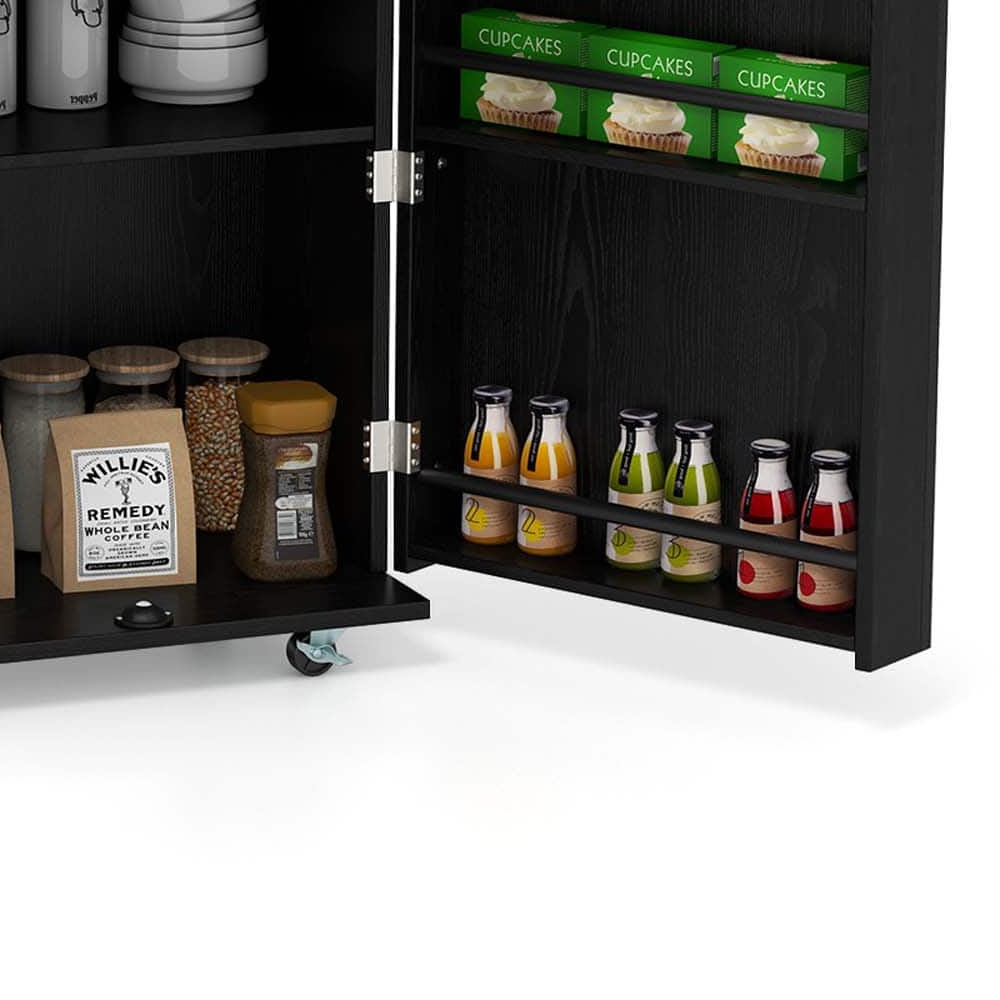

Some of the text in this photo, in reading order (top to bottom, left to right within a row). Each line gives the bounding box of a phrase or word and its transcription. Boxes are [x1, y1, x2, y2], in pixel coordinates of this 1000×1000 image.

[478, 28, 563, 57] CUPCAKES
[606, 48, 694, 78] CUPCAKES
[737, 69, 826, 99] CUPCAKES
[82, 457, 166, 485] WILLIE'S
[88, 504, 165, 521] REMEDY
[85, 526, 129, 536] WHOLE
[134, 520, 169, 531] BEAN
[105, 533, 150, 542] COFFEE
